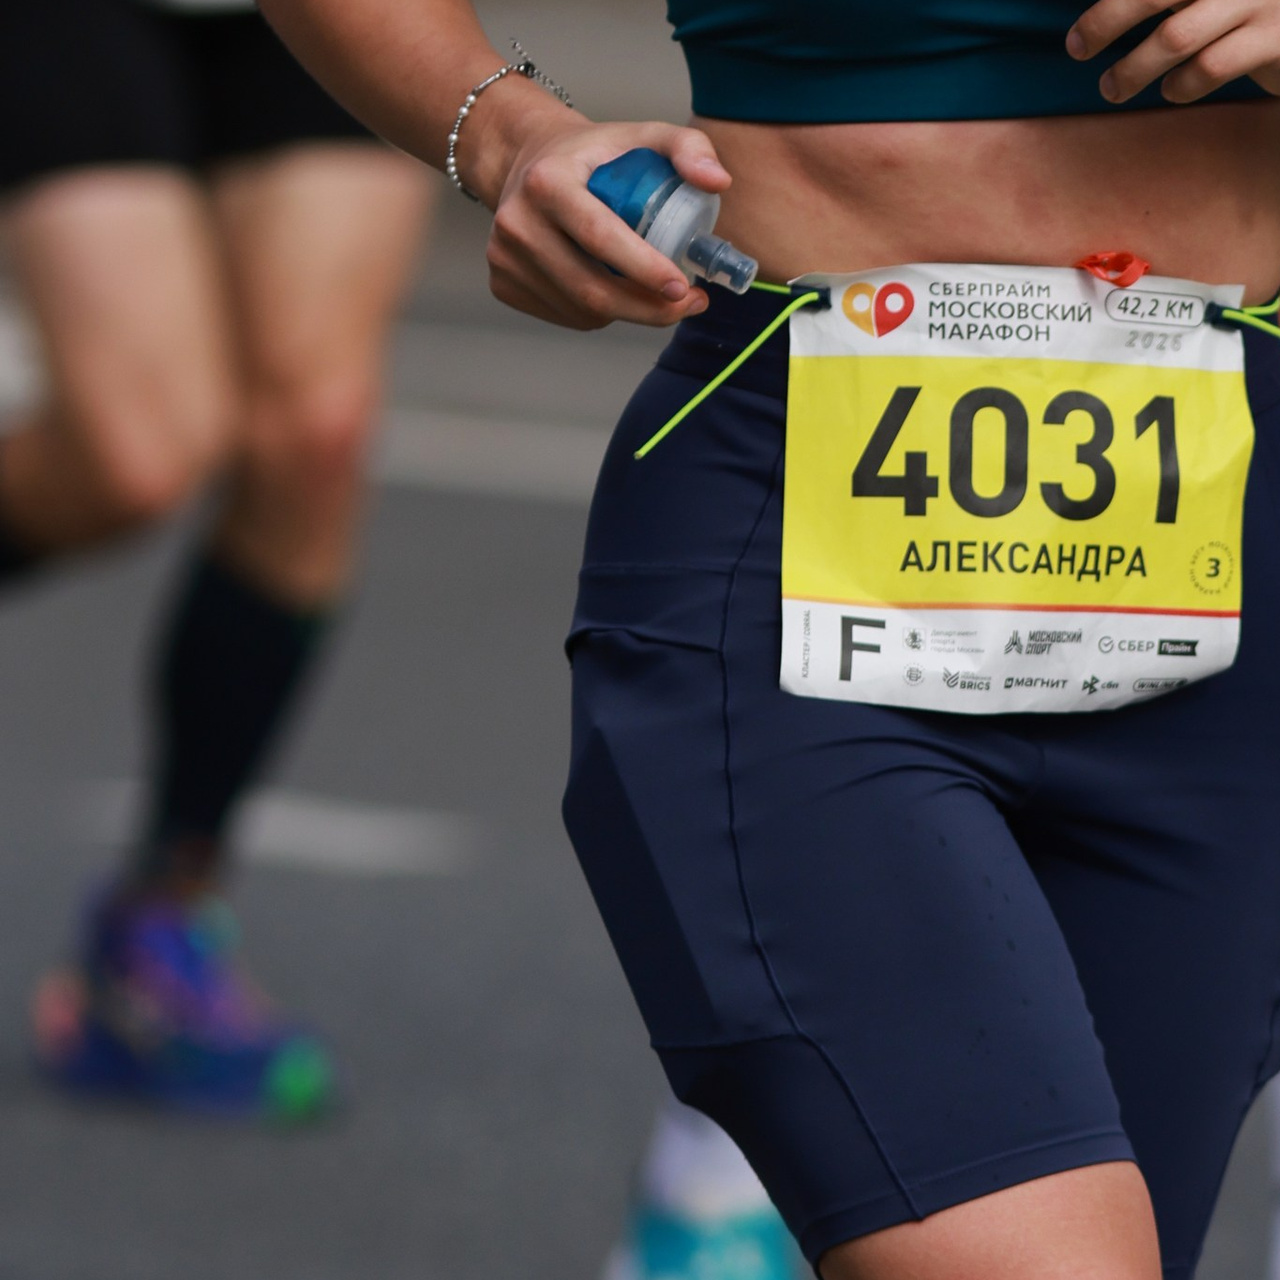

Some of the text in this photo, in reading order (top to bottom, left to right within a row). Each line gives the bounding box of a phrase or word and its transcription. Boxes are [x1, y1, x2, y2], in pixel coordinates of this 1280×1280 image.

[929, 281, 1051, 298] СБЕРПРАЙМ
[928, 300, 1092, 323] МОСКОВСКИЙ
[1117, 295, 1194, 320] 42,2 КМ
[928, 323, 1051, 342] МАРАФОН
[851, 386, 1181, 525] 4031
[899, 540, 1148, 582] АЛЕКСАНДРА
[1205, 557, 1221, 578] 3
[1028, 628, 1083, 643] МОСКОВСКИЙ
[1118, 639, 1155, 652] СБЕР
[839, 615, 886, 682] F
[1025, 643, 1051, 655] СПОРТ
[960, 681, 991, 691] BRICS
